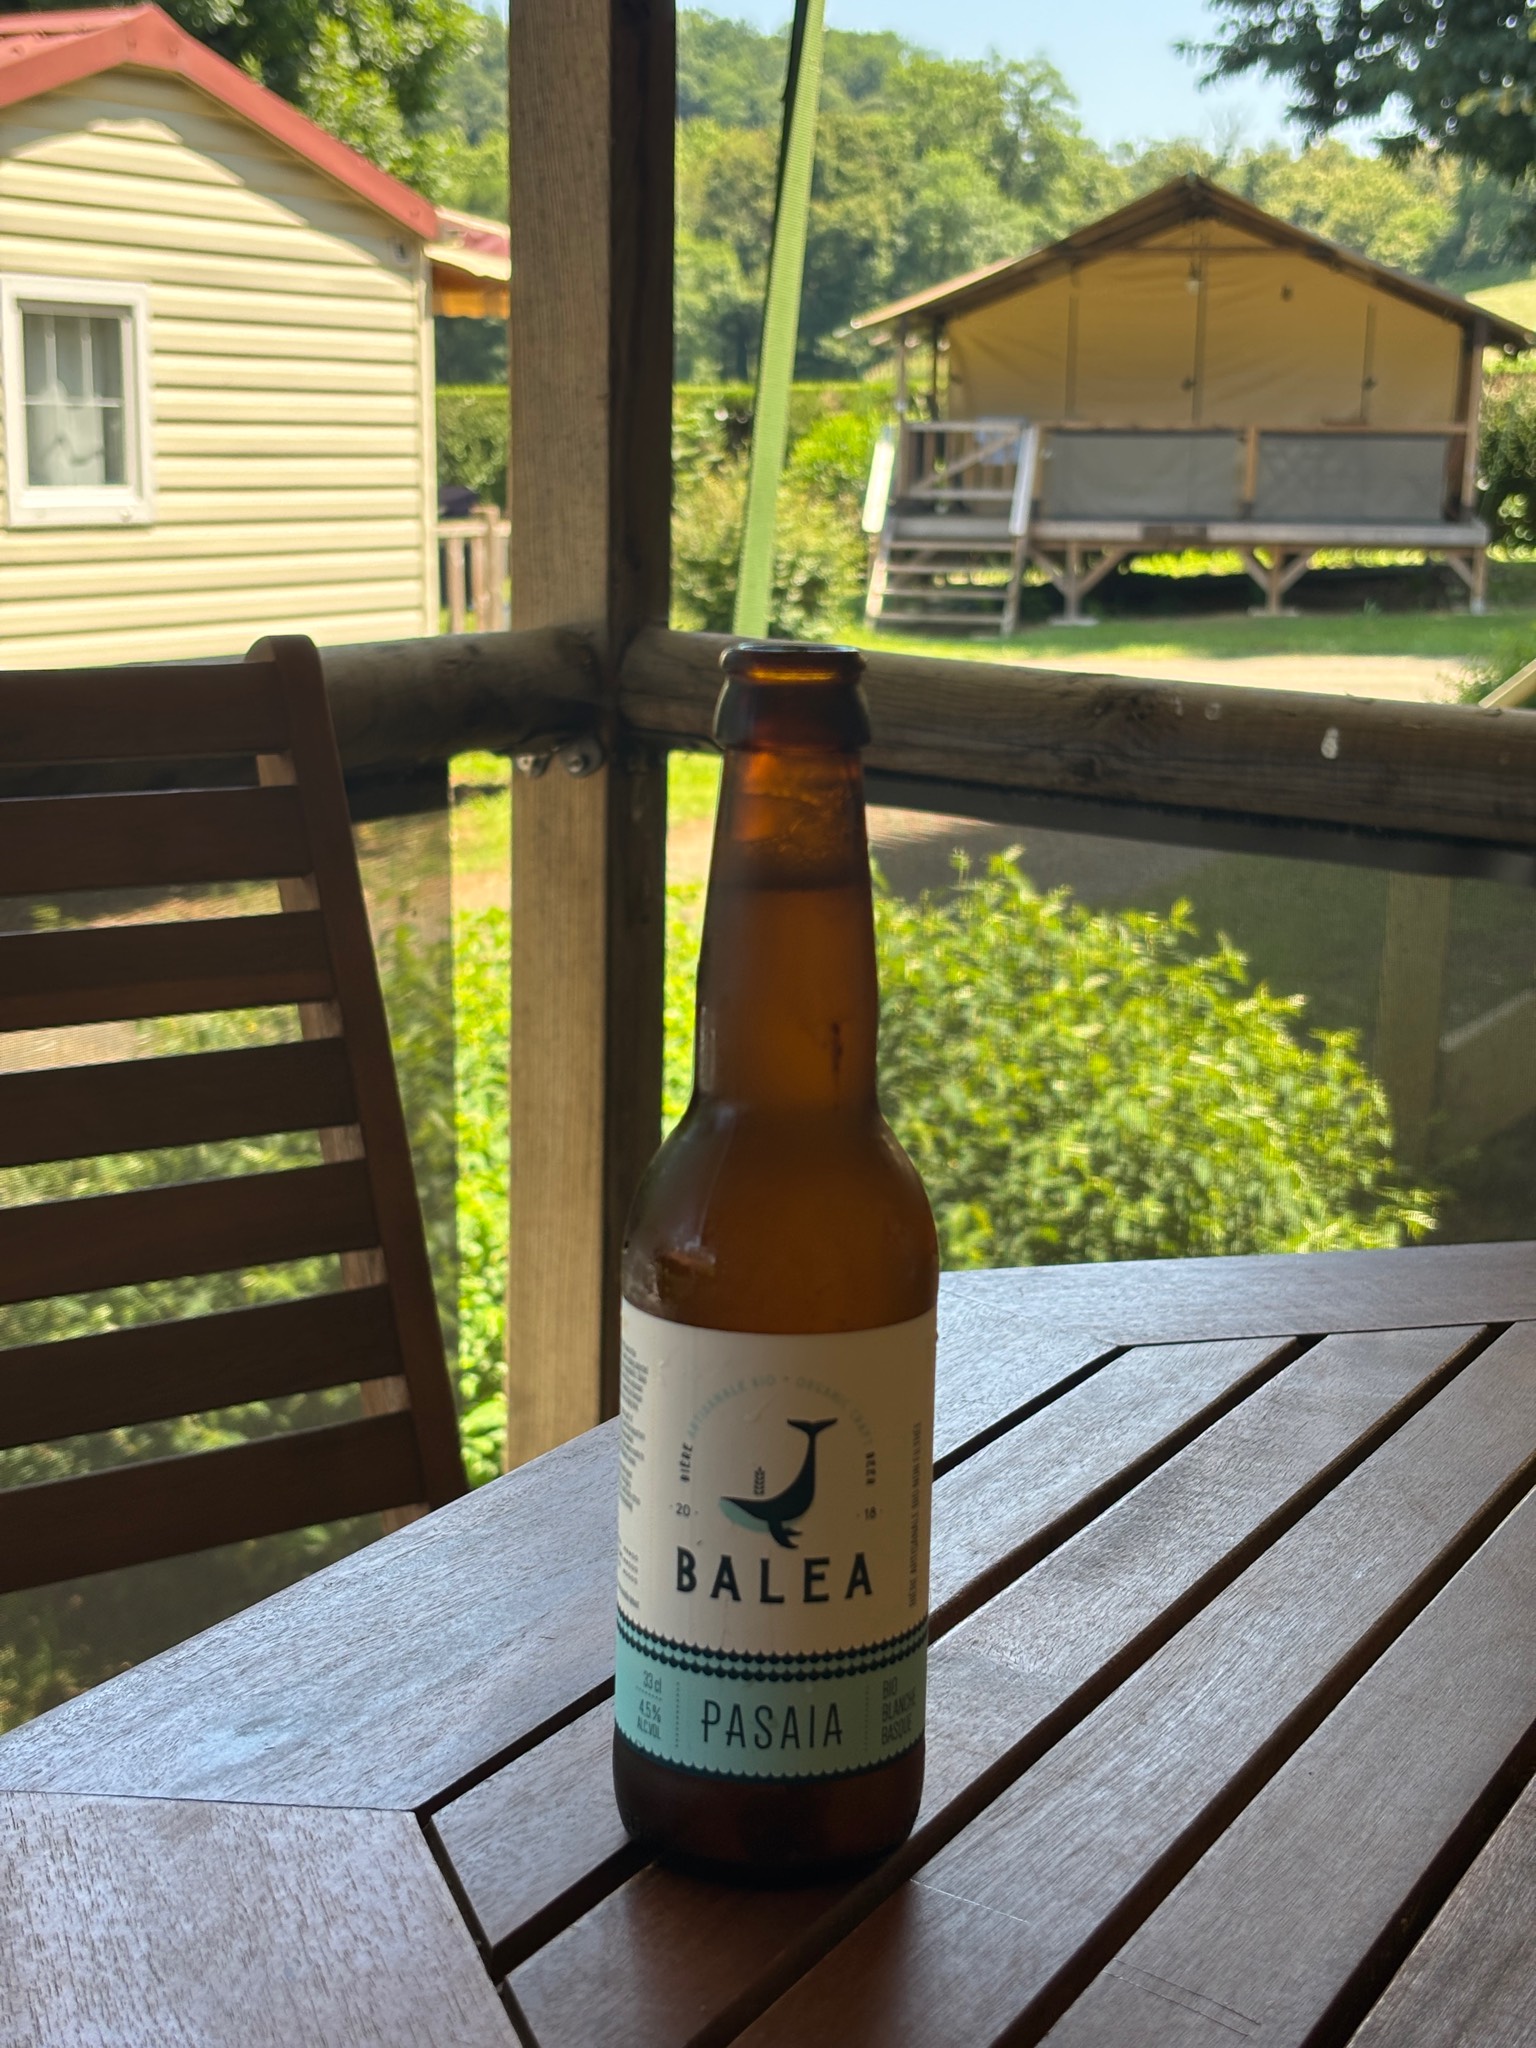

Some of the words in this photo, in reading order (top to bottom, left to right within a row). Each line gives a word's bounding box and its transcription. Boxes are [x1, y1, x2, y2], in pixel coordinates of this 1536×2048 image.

[676, 1502, 691, 1517] 20
[676, 1545, 873, 1604] BALEA
[643, 1670, 654, 1690] 33
[654, 1678, 662, 1693] cl
[882, 1676, 898, 1700] BIO
[701, 1699, 842, 1750] PASAIA
[881, 1711, 912, 1745] BASQUE
